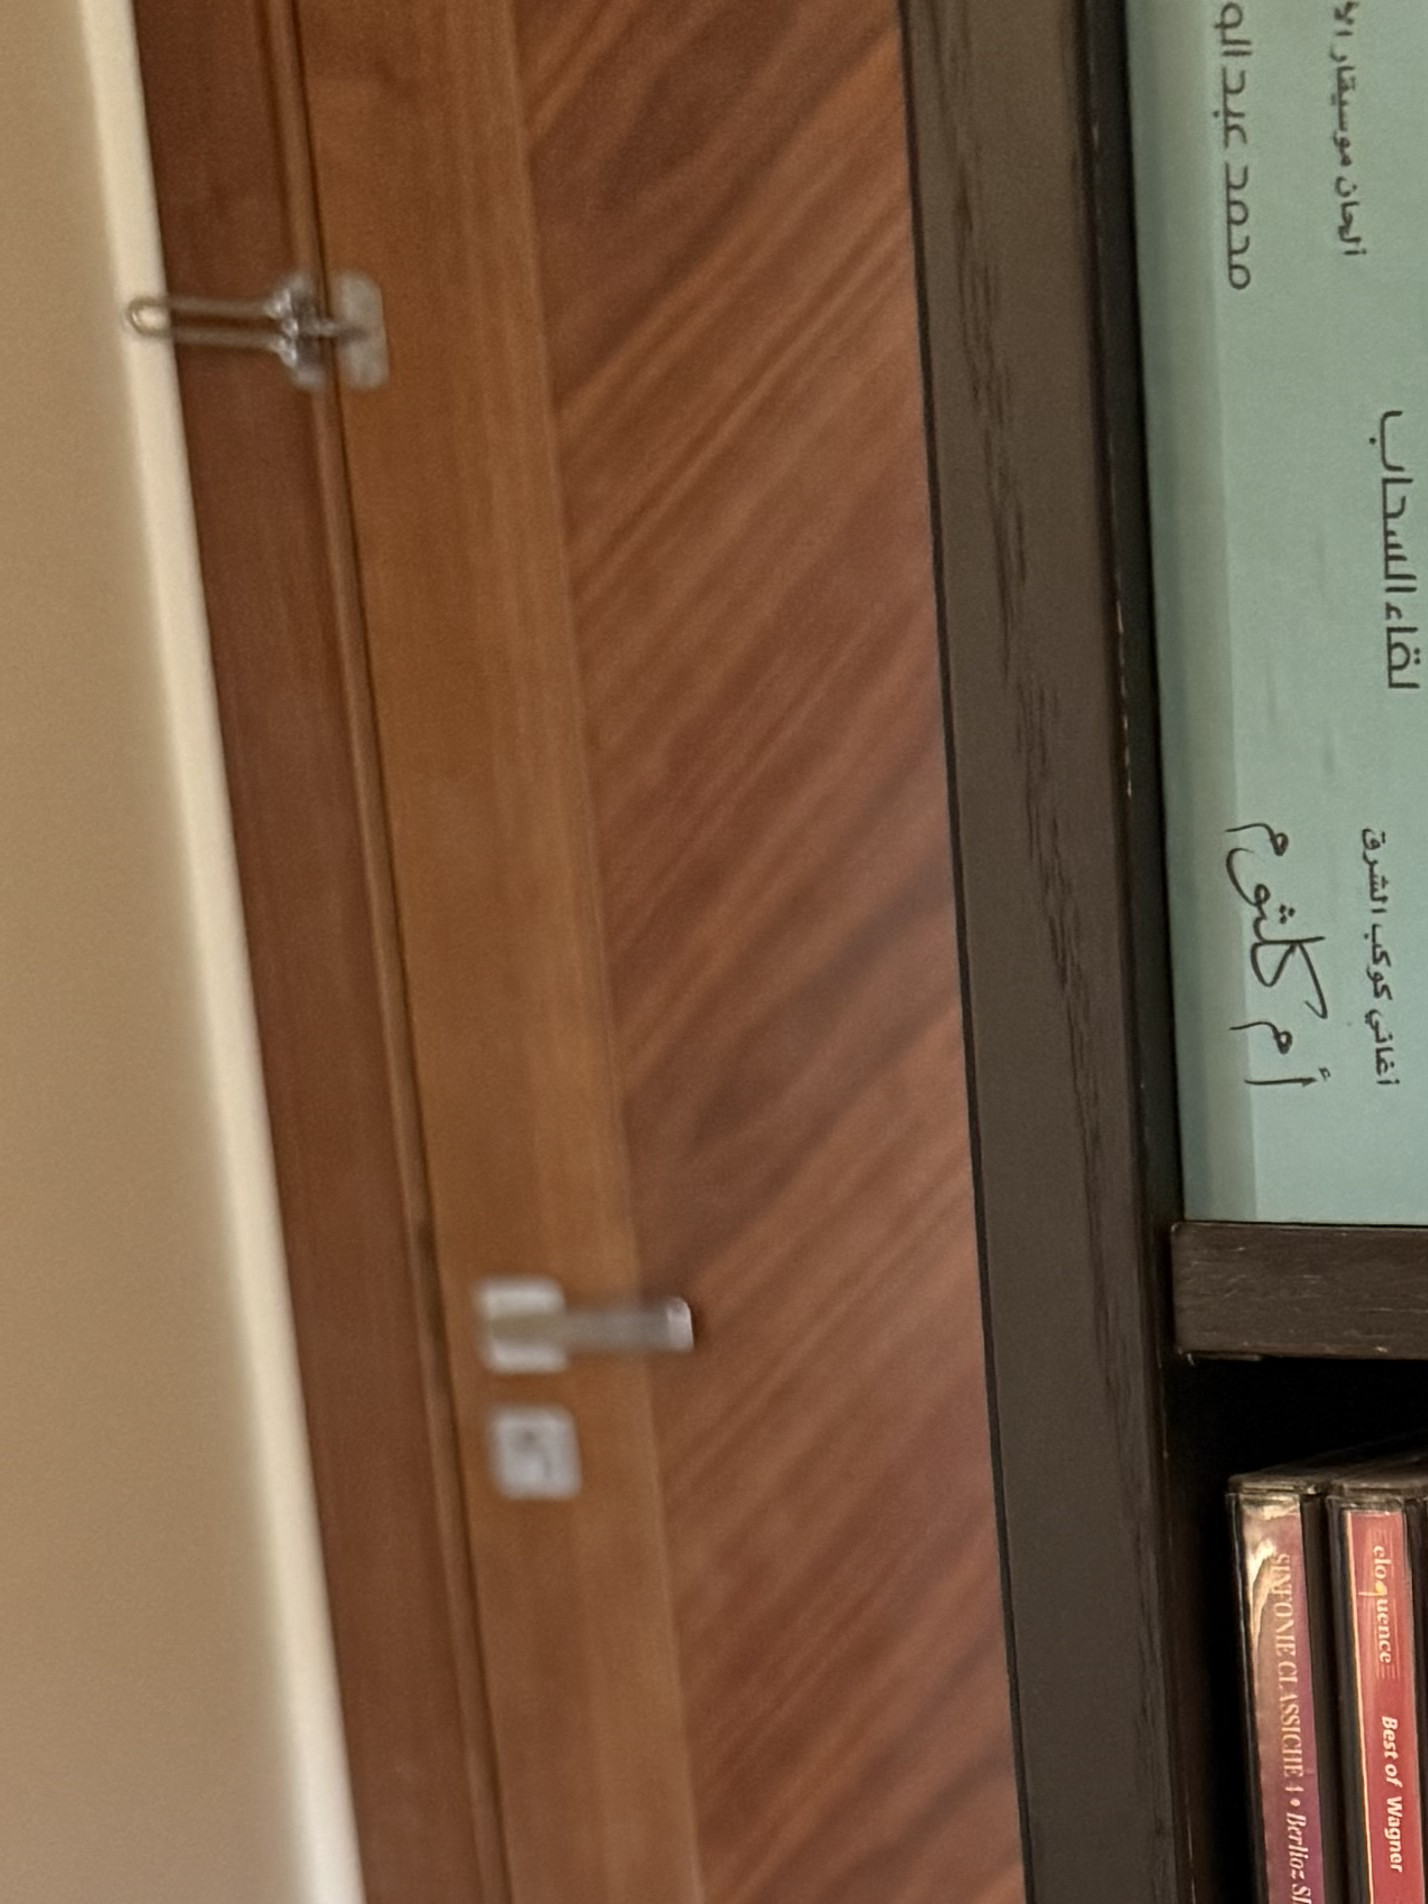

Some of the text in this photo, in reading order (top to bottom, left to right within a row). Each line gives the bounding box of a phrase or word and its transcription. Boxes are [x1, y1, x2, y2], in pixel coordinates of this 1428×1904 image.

[1212, 68, 1252, 291] محمد عبد
[1369, 411, 1420, 691] لقاء السحاب
[1226, 822, 1328, 1019] كلثوم
[1363, 829, 1389, 912] الشرق
[1365, 923, 1392, 1000] كوكب
[1270, 1554, 1297, 1656] SINFONIE
[1278, 1661, 1304, 1776] CLASSICHE
[1286, 1812, 1309, 1879] Berlioz
[1381, 1716, 1403, 1873] Best Wagner
